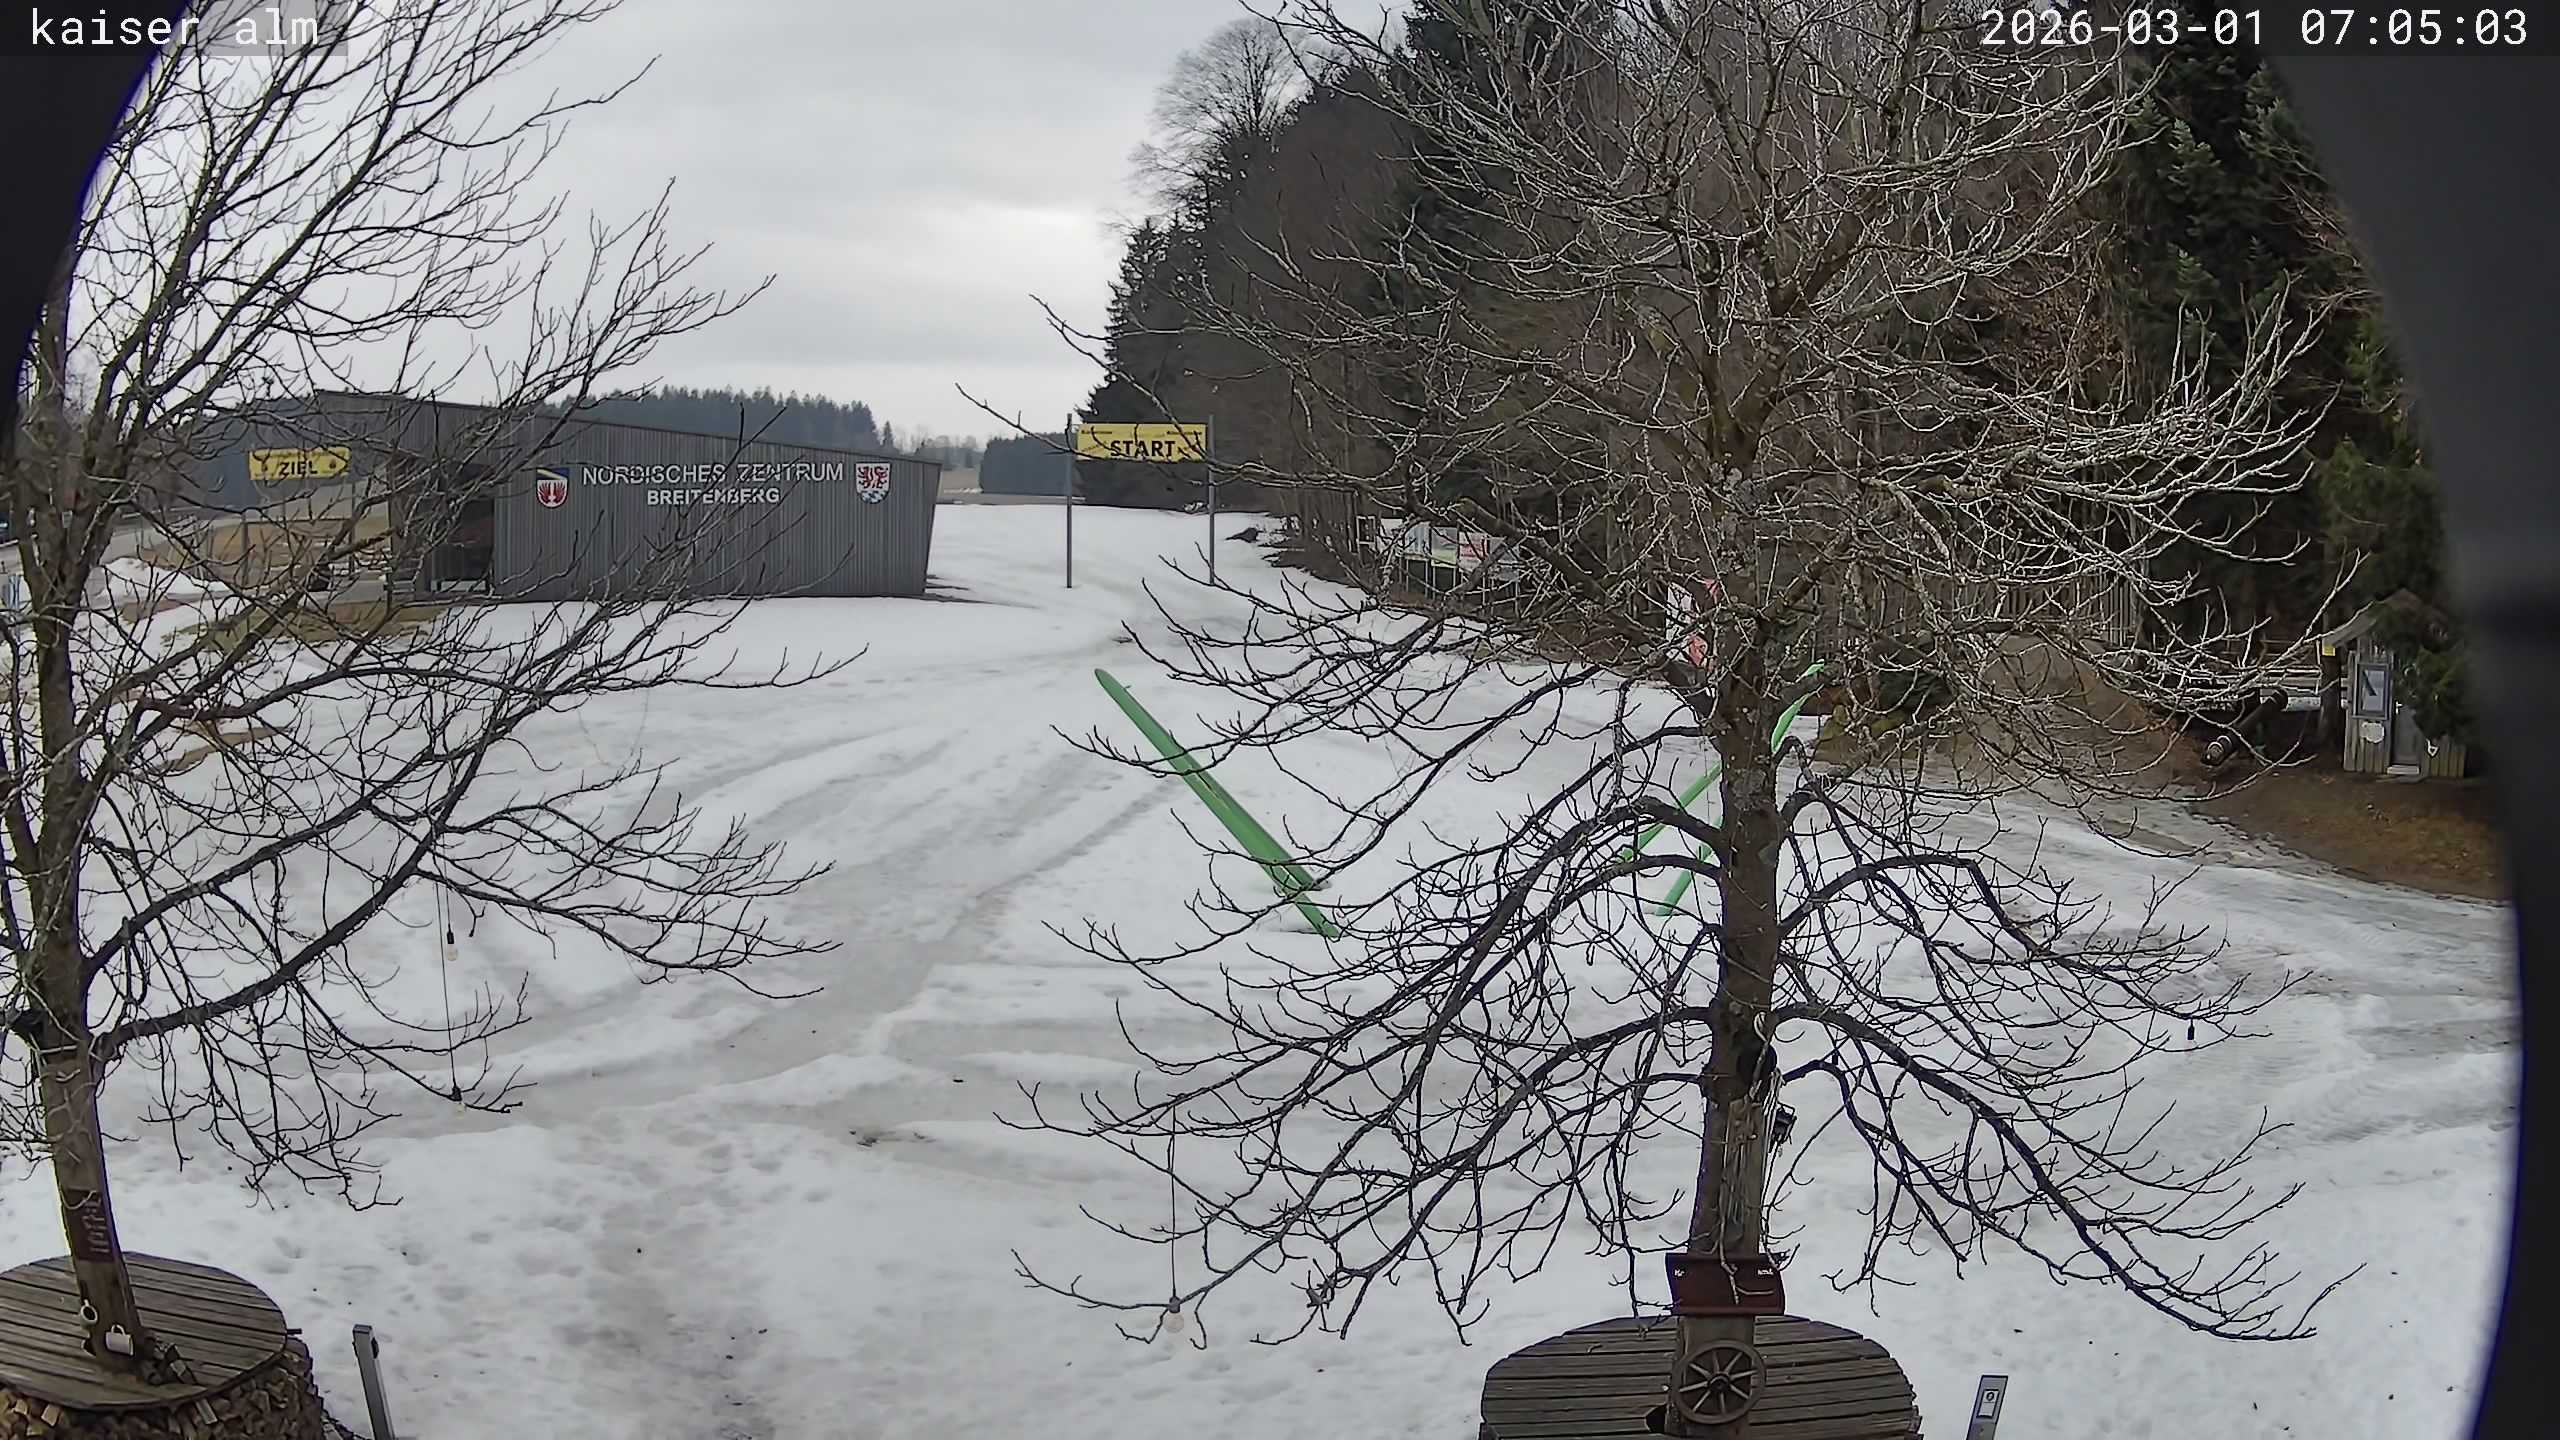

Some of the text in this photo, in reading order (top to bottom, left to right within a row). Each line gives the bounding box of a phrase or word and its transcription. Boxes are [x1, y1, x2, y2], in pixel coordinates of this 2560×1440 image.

[1110, 440, 1176, 457] START
[279, 460, 318, 475] ZIEL
[582, 463, 843, 485] NORDISCHES ZENTRUM
[647, 487, 781, 506] BREITENBERG
